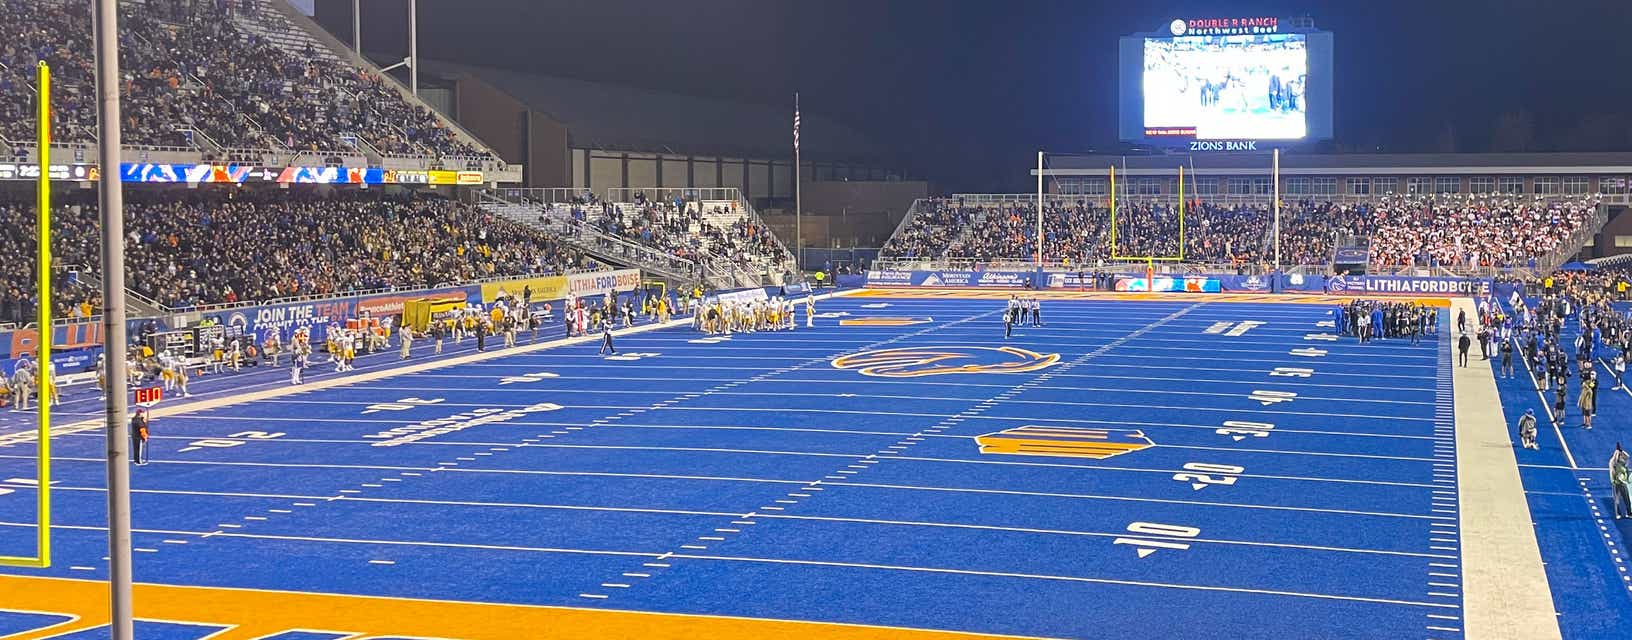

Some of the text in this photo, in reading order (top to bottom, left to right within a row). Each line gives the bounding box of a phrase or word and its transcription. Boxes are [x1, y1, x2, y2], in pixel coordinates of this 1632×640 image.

[1189, 19, 1229, 28] DOUBLE
[1241, 18, 1277, 27] RANCH
[1253, 26, 1278, 34] Beef
[1190, 140, 1257, 151] ZIONS BANK
[254, 308, 286, 324] JOIN
[289, 305, 313, 320] THE
[315, 302, 349, 317] TEAM
[1215, 420, 1276, 438] 30
[1172, 462, 1245, 486] 20
[1113, 521, 1201, 550] 10
